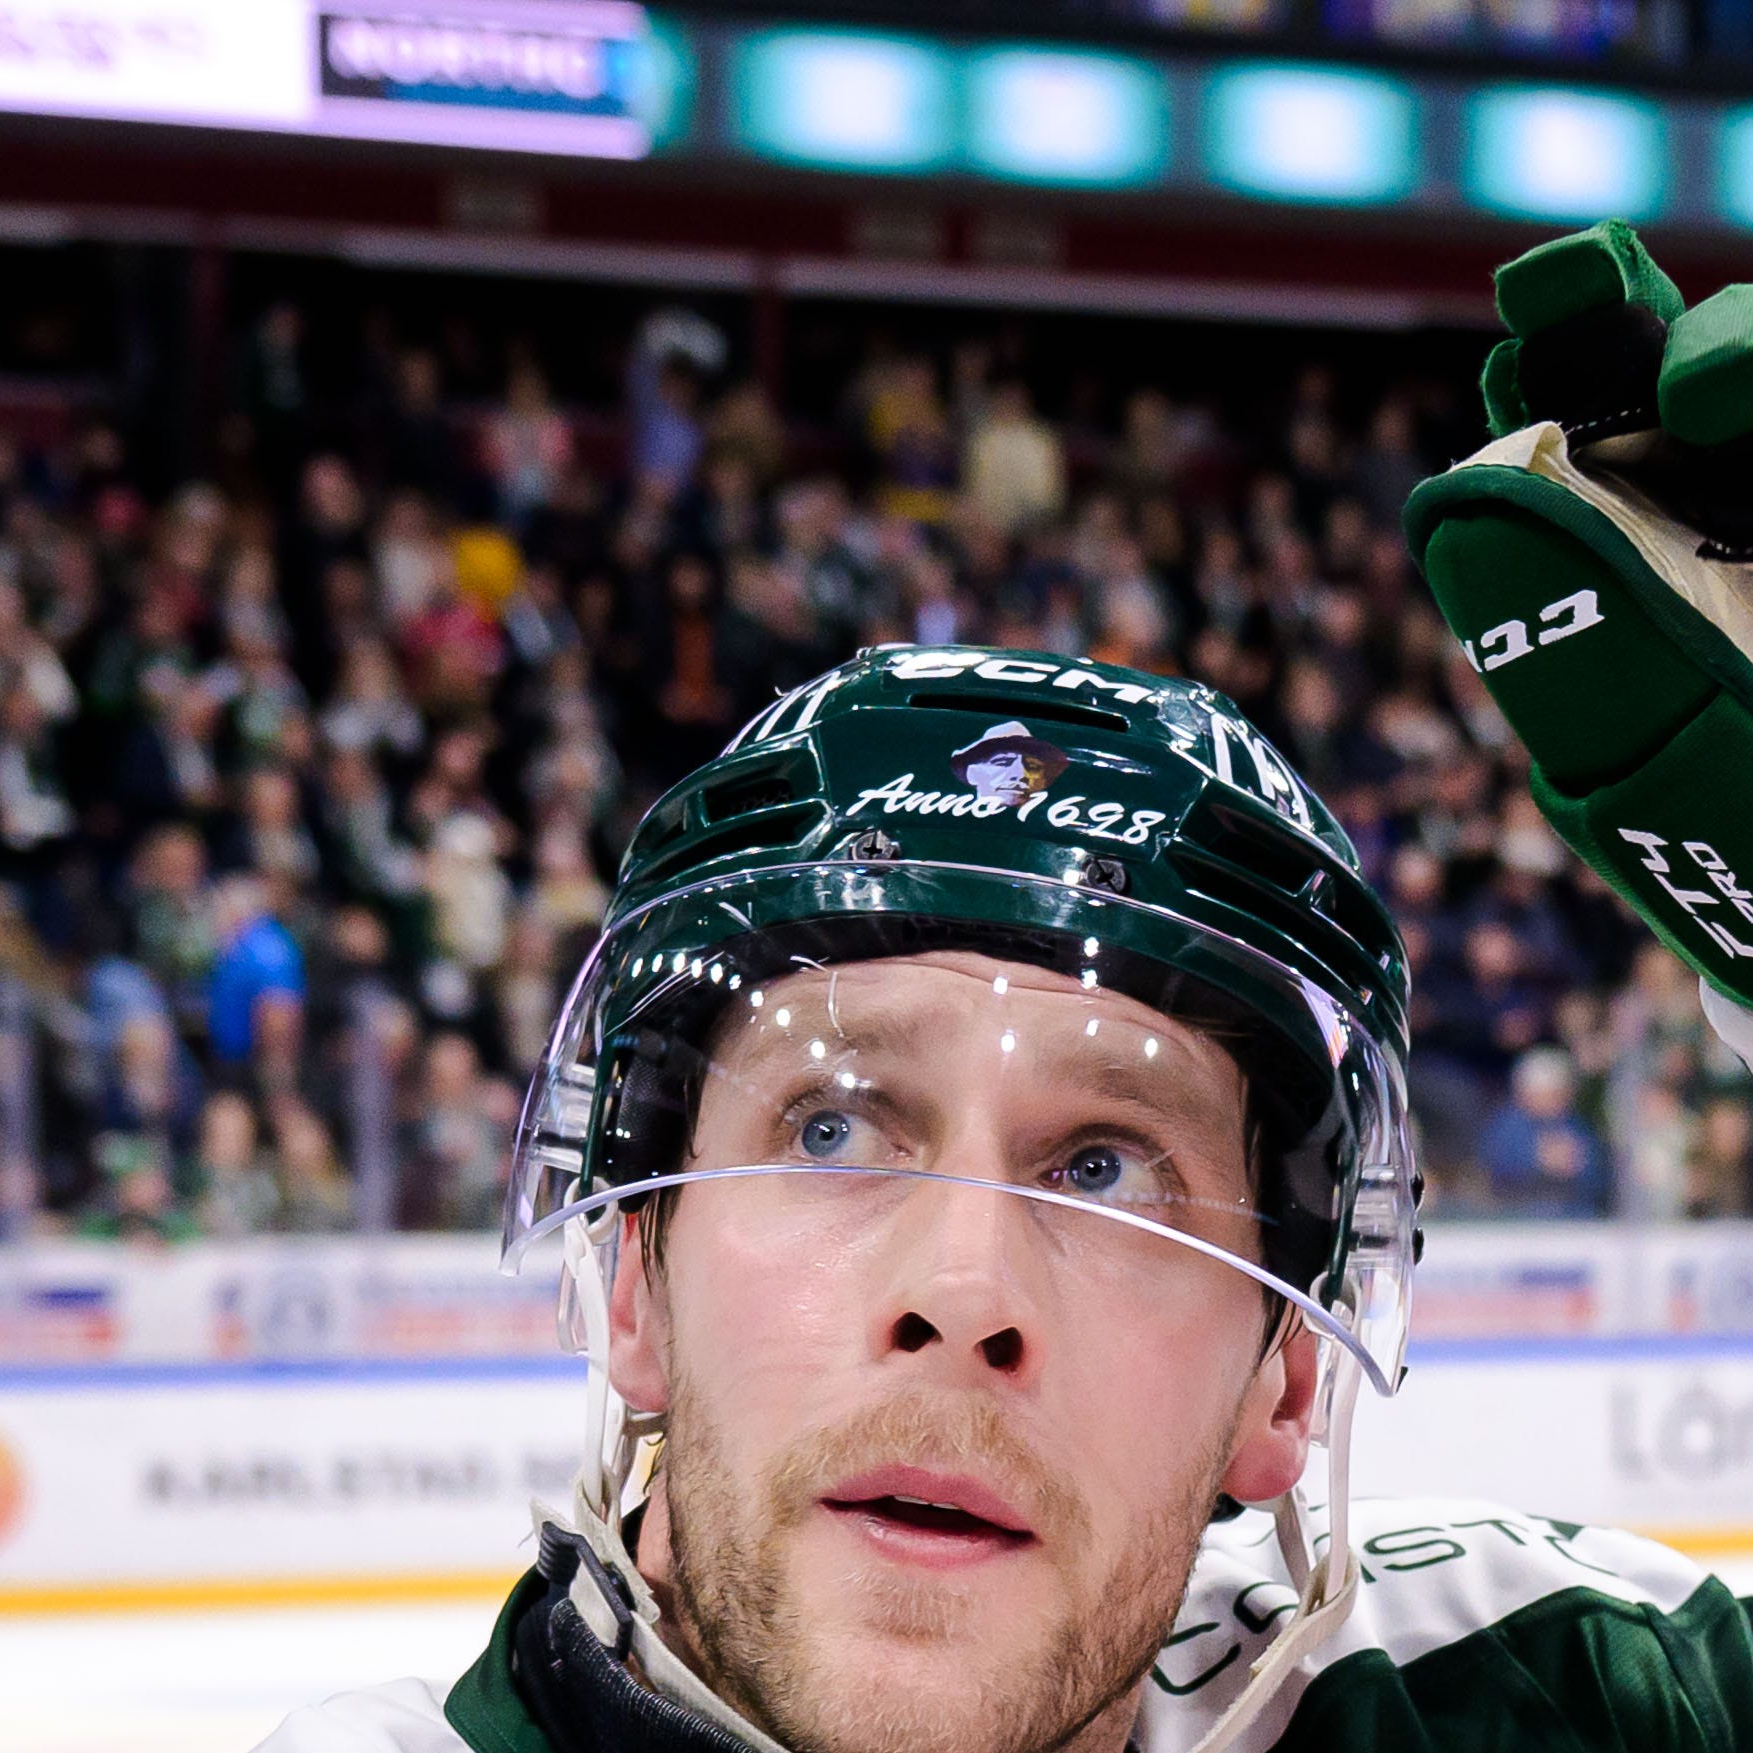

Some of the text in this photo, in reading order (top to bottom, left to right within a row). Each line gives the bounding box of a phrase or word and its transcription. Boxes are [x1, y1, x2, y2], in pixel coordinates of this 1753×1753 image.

[1463, 589, 1604, 672] CC
[846, 773, 1167, 845] Anno 1698
